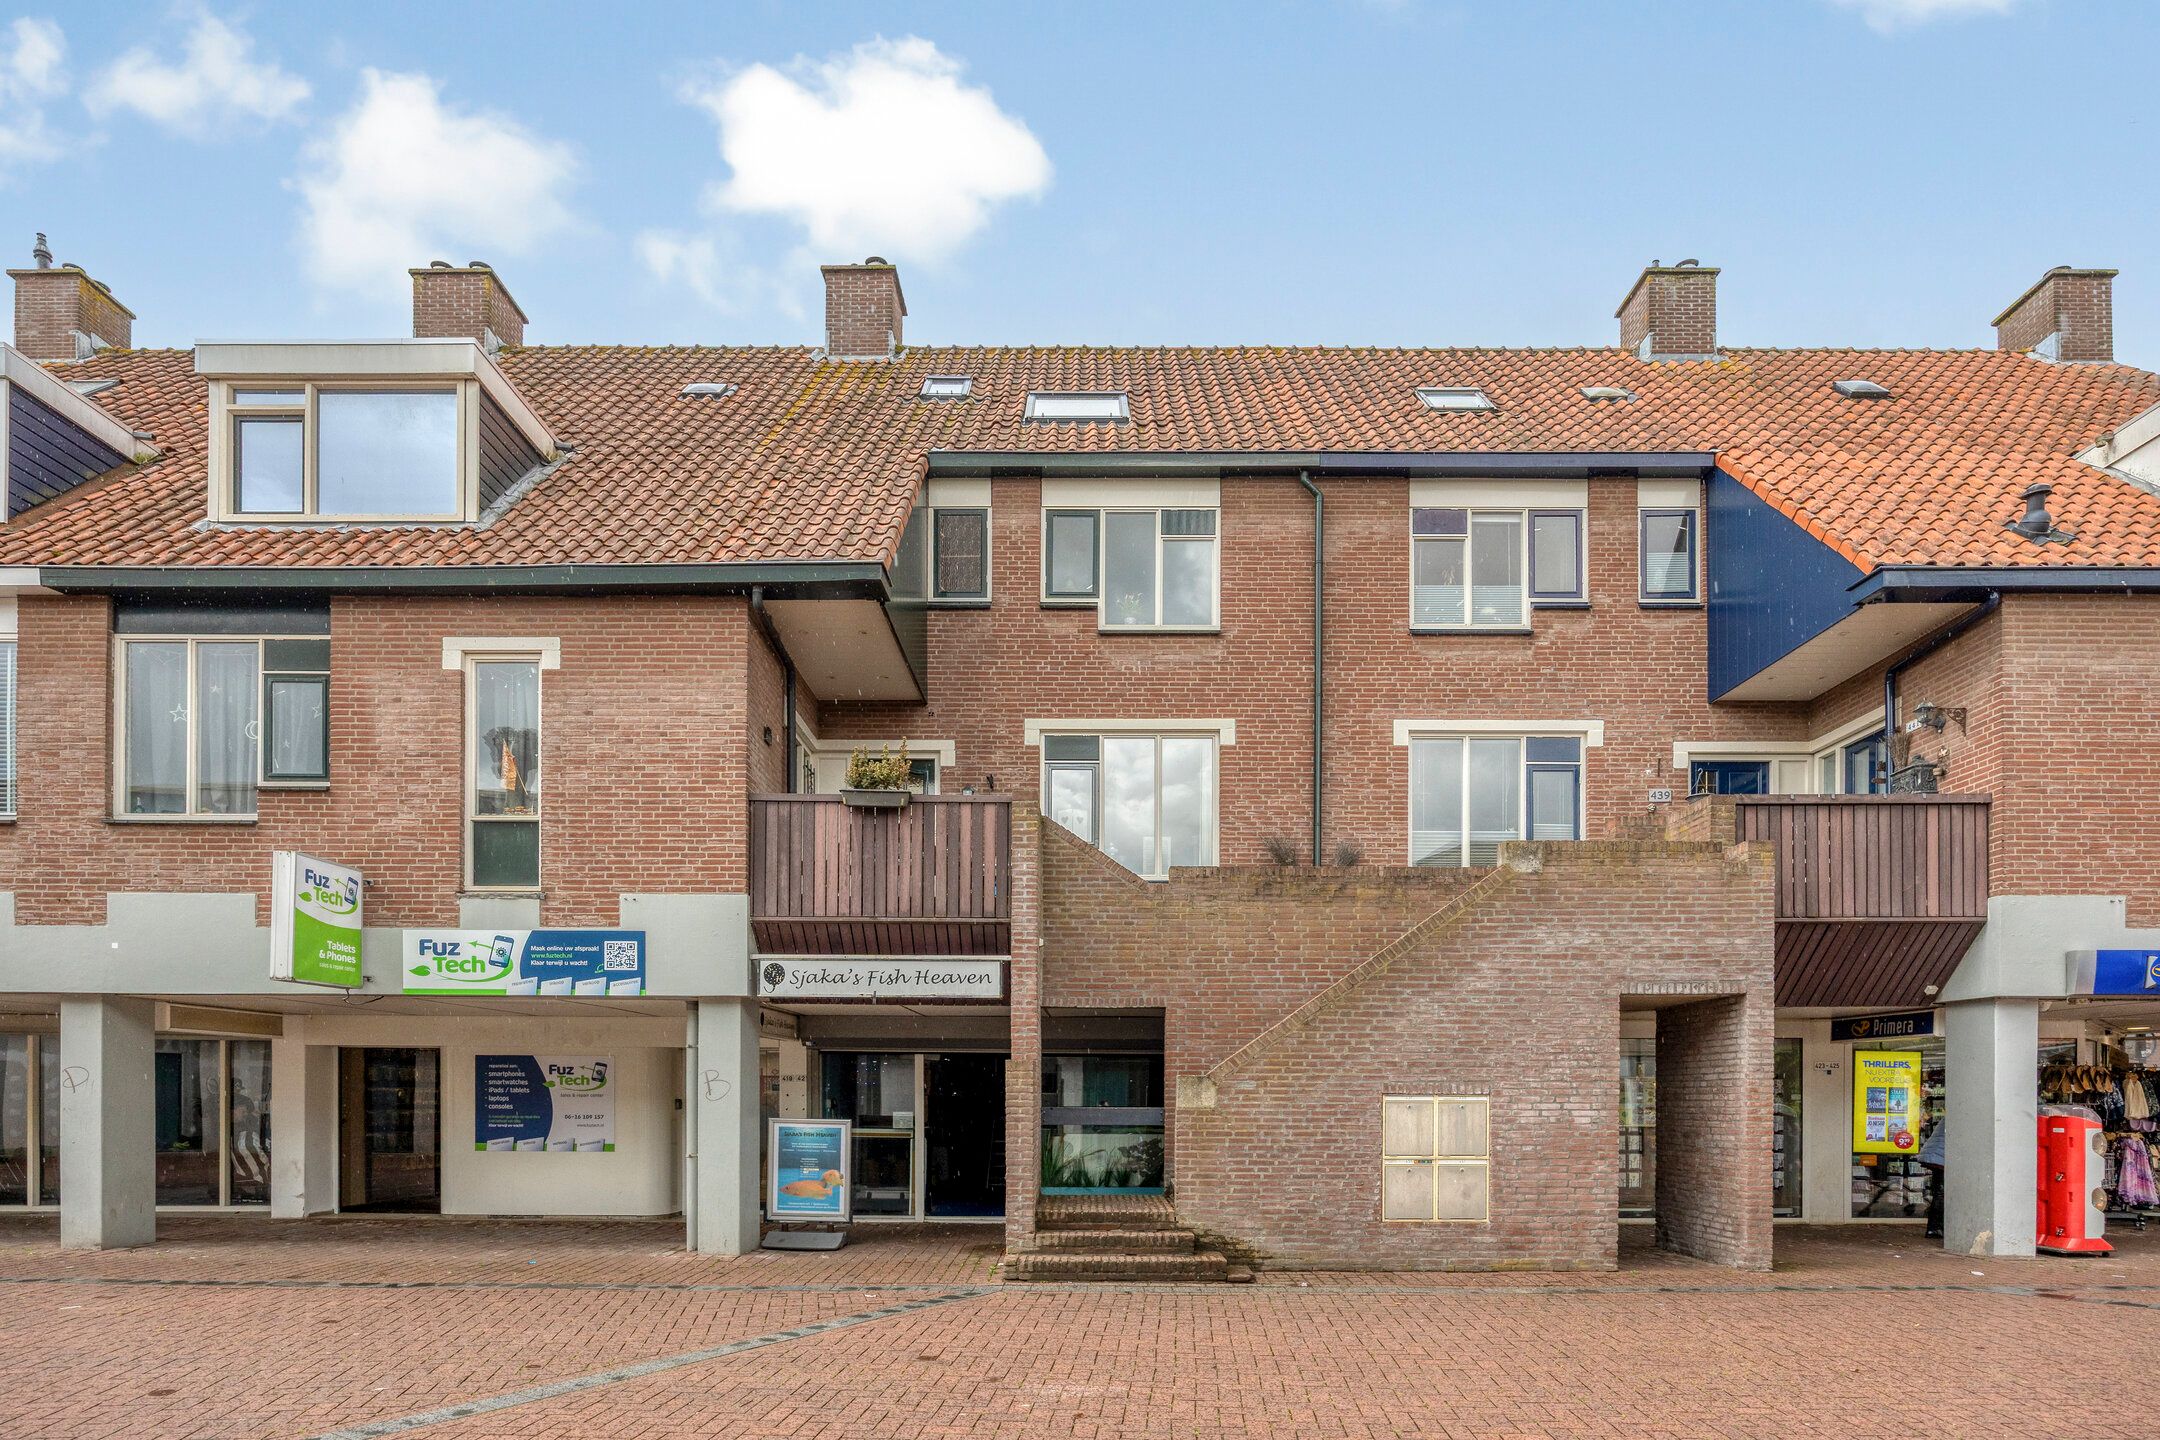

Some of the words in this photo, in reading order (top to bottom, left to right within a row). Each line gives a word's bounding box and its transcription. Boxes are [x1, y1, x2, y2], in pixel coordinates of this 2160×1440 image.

[1650, 790, 1671, 800] 439
[304, 868, 330, 889] Fuz
[313, 886, 343, 908] Tech
[327, 940, 357, 954] Tablets
[418, 938, 461, 956] Fuz
[574, 945, 600, 953] afspraak!
[319, 949, 327, 960] &
[326, 950, 357, 964] Phones
[432, 955, 486, 974] Tech
[867, 968, 912, 987] Fish
[914, 969, 992, 986] Heaven
[1873, 1018, 1914, 1036] Primera
[548, 1064, 575, 1075] Fuz
[556, 1075, 590, 1086] Tech
